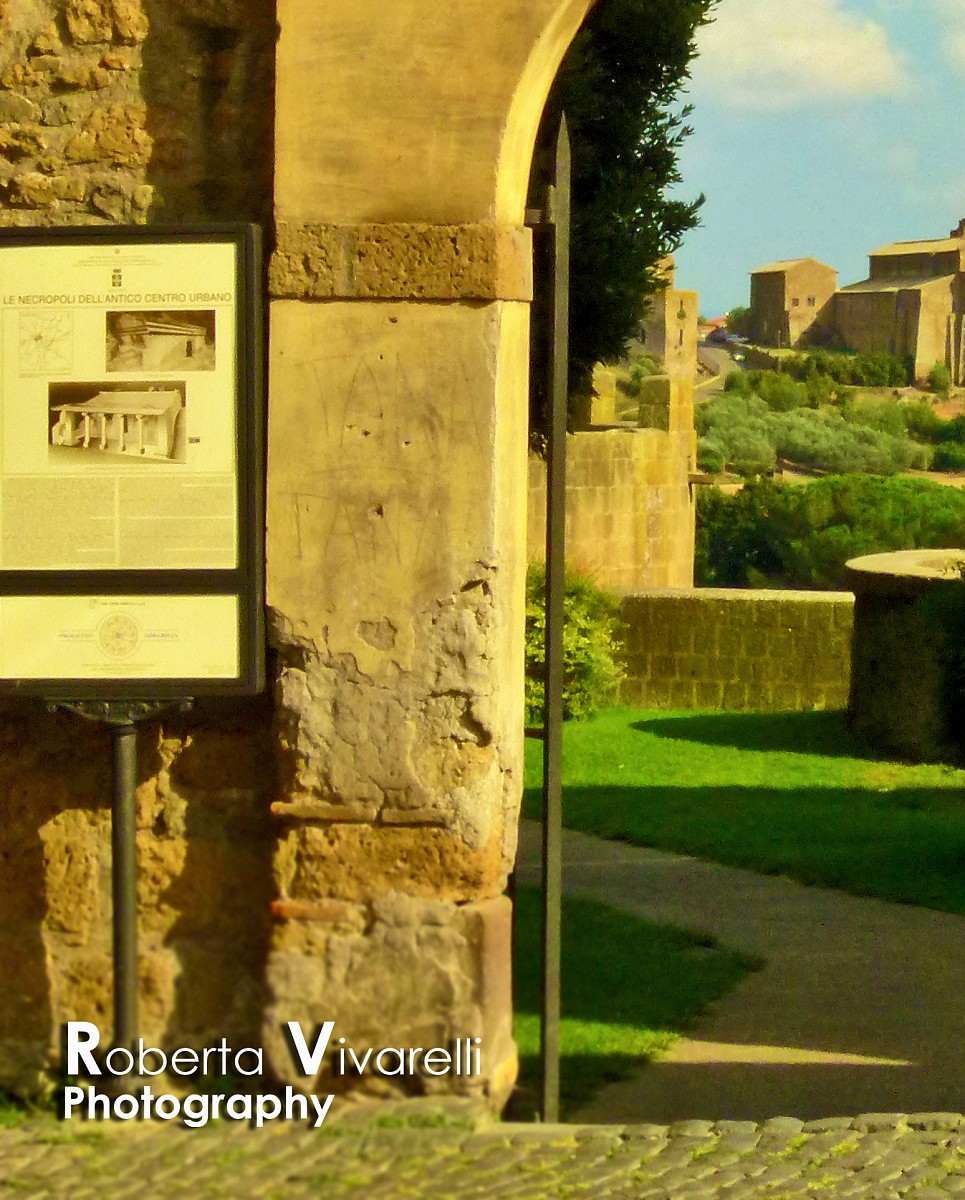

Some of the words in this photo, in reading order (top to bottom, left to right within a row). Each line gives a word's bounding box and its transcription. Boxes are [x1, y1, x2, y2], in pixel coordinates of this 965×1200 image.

[3, 295, 16, 305] LE
[18, 294, 76, 305] NECROPOLI
[144, 293, 187, 303] CENTRO
[189, 292, 232, 303] URBANO
